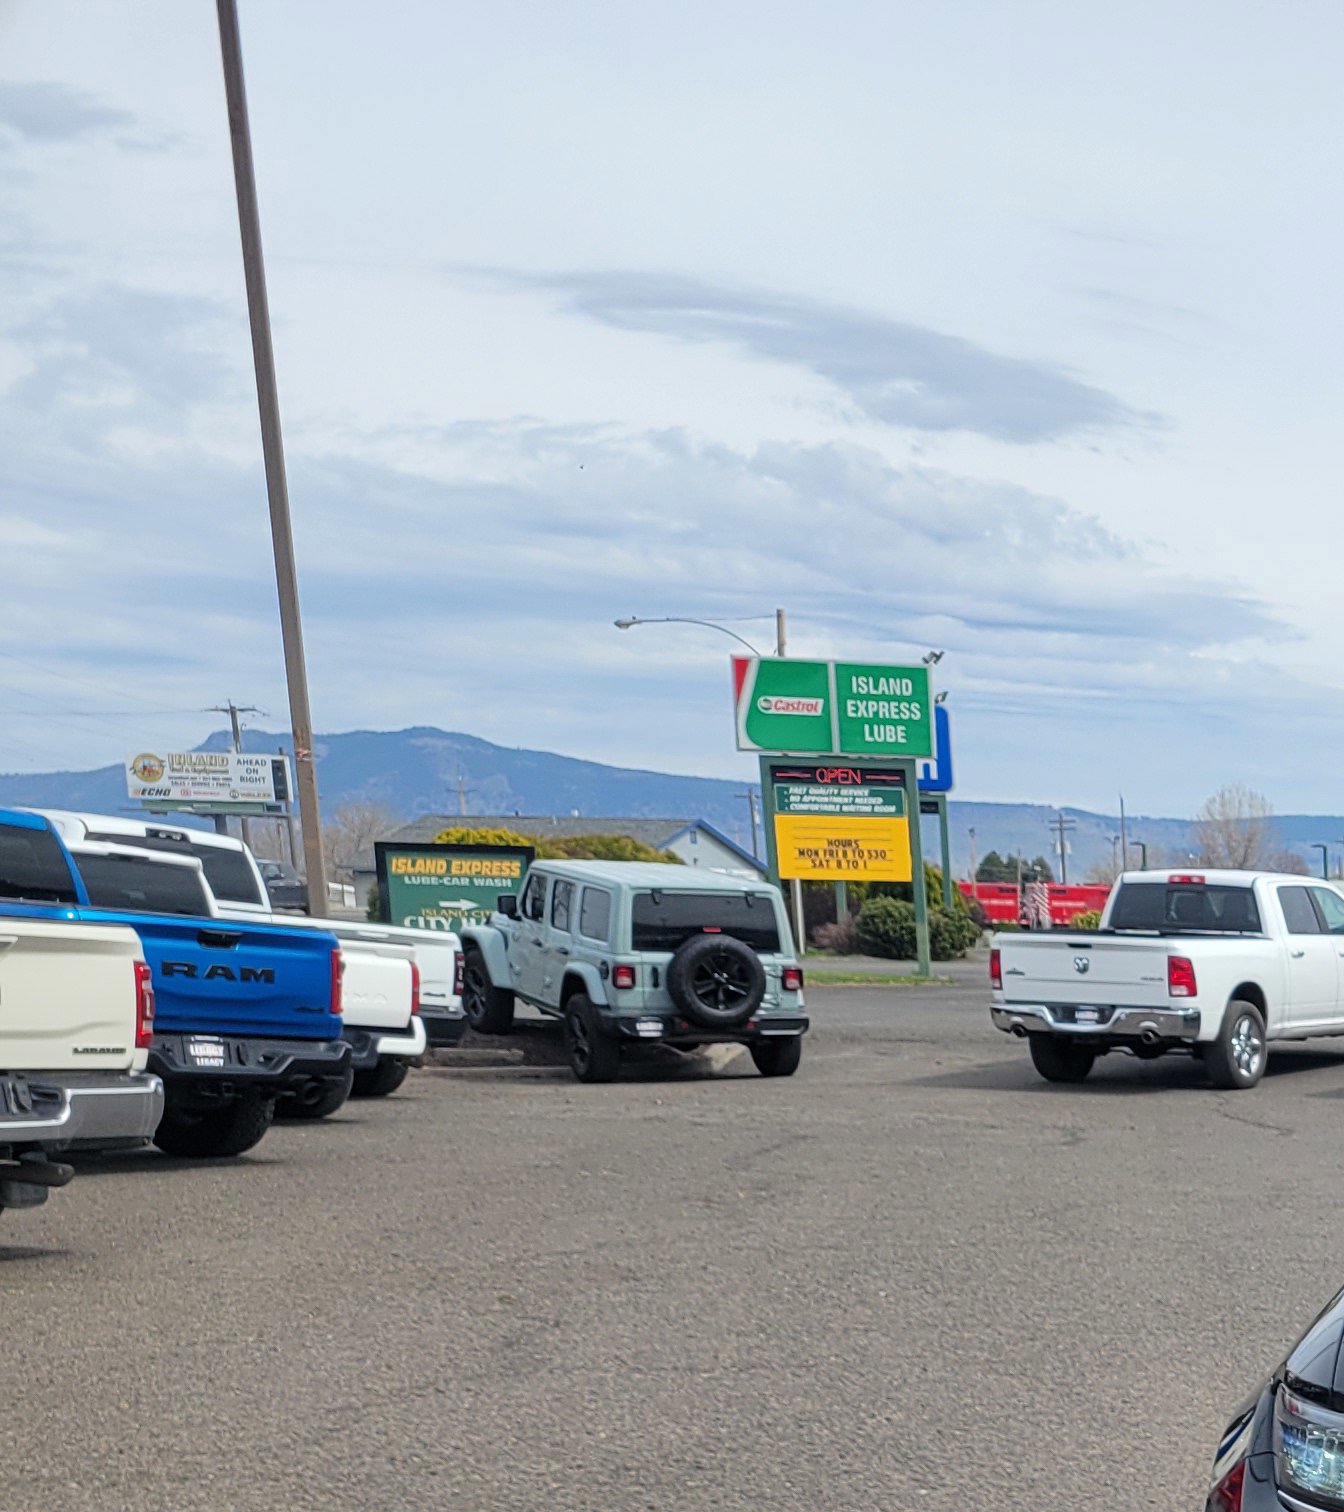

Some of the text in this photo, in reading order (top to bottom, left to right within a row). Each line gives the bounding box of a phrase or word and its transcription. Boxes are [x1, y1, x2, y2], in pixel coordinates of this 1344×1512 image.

[852, 676, 913, 696] ISLAND
[774, 700, 819, 713] Castrol
[846, 699, 921, 721] EXPRESS
[864, 723, 907, 743] LUBE
[245, 767, 259, 775] ON
[816, 767, 862, 785] OPEN
[240, 776, 266, 784] RIGHT
[141, 787, 171, 797] ECHO
[808, 787, 839, 796] QUALITY
[801, 795, 854, 804] APPOINTMENT
[827, 839, 860, 849] HOURS
[798, 848, 819, 858] MON
[823, 849, 839, 858] FRI
[852, 849, 865, 859] TO
[391, 856, 521, 878] ISLAND EXPRESS
[811, 859, 830, 869] SAT
[846, 860, 859, 869] TO
[473, 877, 512, 888] WASH
[421, 908, 468, 918] ISLAND
[404, 915, 452, 931] CITY
[161, 960, 275, 984] RAM
